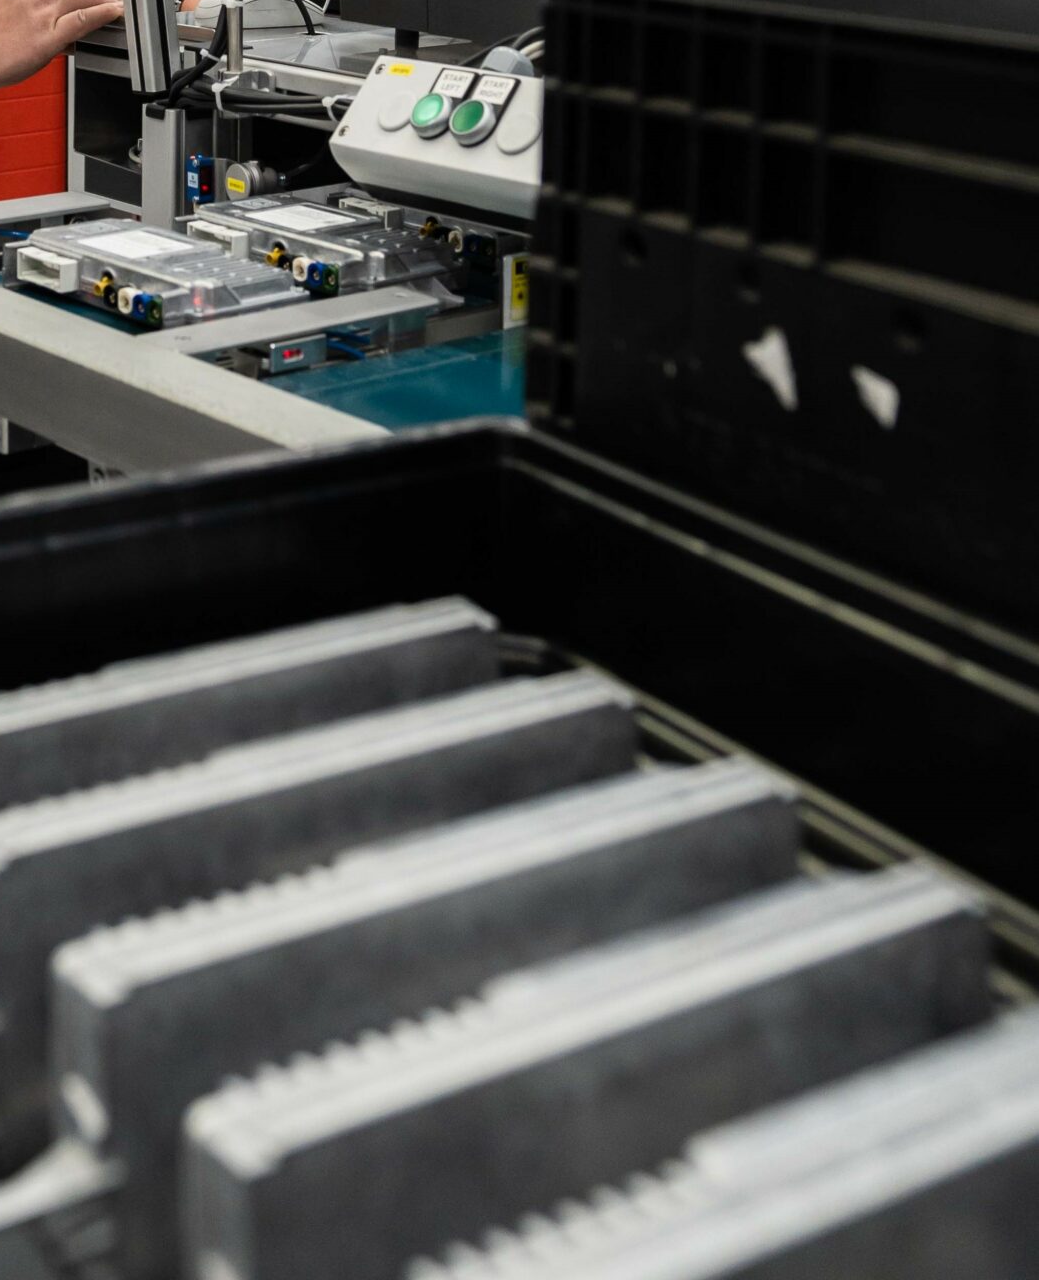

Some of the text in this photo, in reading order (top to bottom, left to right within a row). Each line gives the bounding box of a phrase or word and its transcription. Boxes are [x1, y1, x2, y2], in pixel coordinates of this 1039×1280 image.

[442, 73, 468, 83] START
[440, 83, 461, 93] LEFT
[483, 80, 510, 90] START
[479, 87, 505, 98] RIGHT
